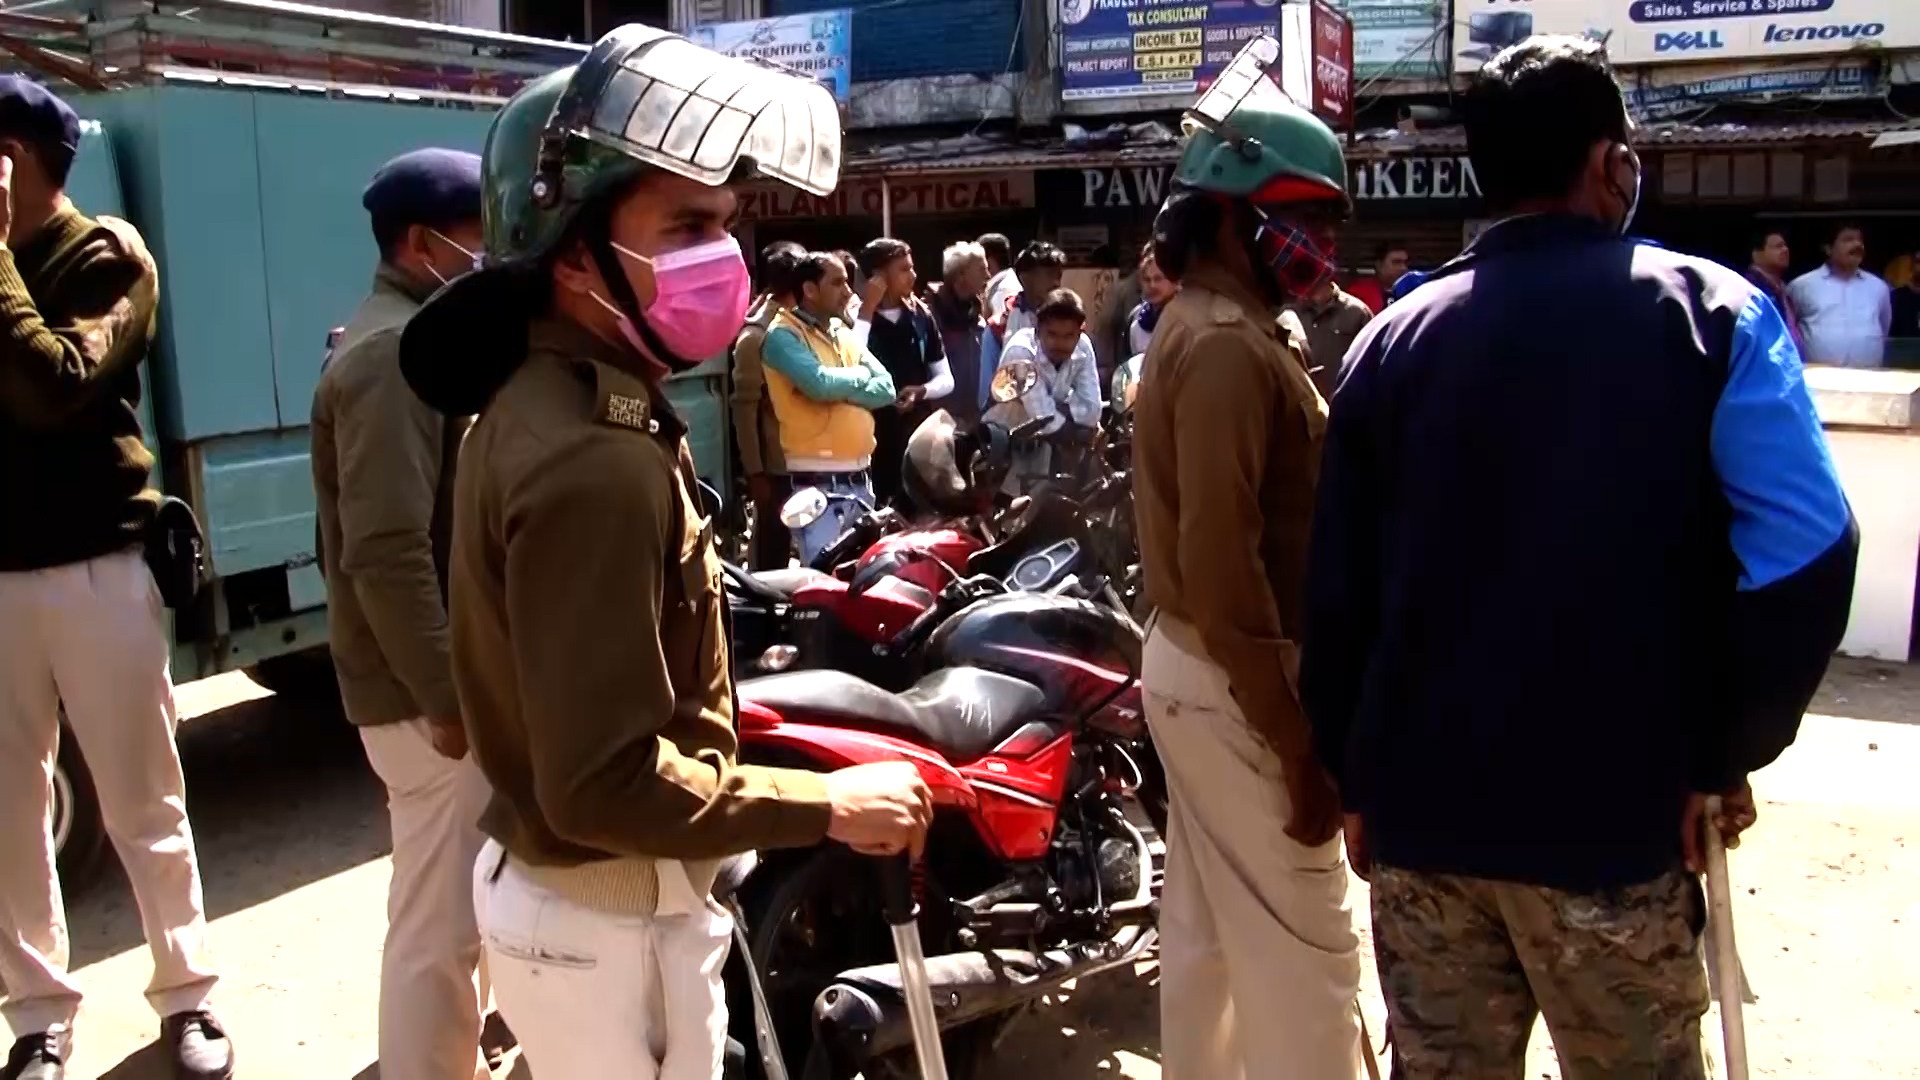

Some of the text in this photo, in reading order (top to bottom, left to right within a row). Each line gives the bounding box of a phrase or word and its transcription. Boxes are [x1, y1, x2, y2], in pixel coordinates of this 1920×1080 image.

[1127, 5, 1208, 26] TAX CONSULTANT
[1644, 0, 1819, 17] Sales, Service & Spares
[1135, 31, 1200, 48] INCOME TAX
[1654, 29, 1724, 52] DELL
[1763, 22, 1885, 43] lenovo
[1067, 61, 1098, 72] PROJECT
[861, 178, 1022, 214] OPTICAL
[1081, 167, 1165, 207] PAW
